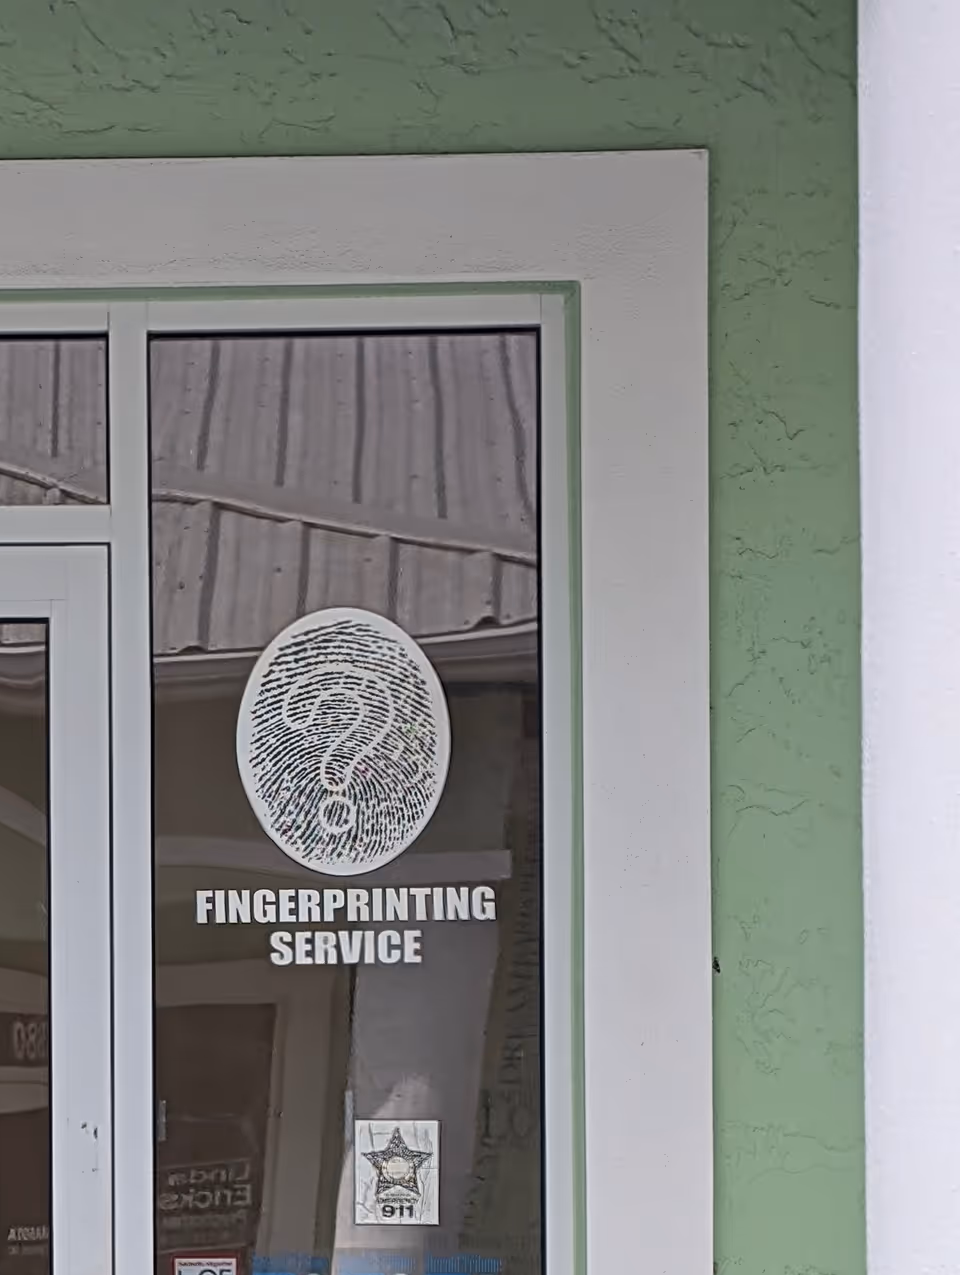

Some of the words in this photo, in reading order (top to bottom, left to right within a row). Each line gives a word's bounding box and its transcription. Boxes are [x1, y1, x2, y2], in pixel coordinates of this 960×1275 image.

[195, 886, 497, 923] FINGERPRINTING
[270, 929, 423, 966] SERVICE
[382, 1204, 414, 1218] 911
